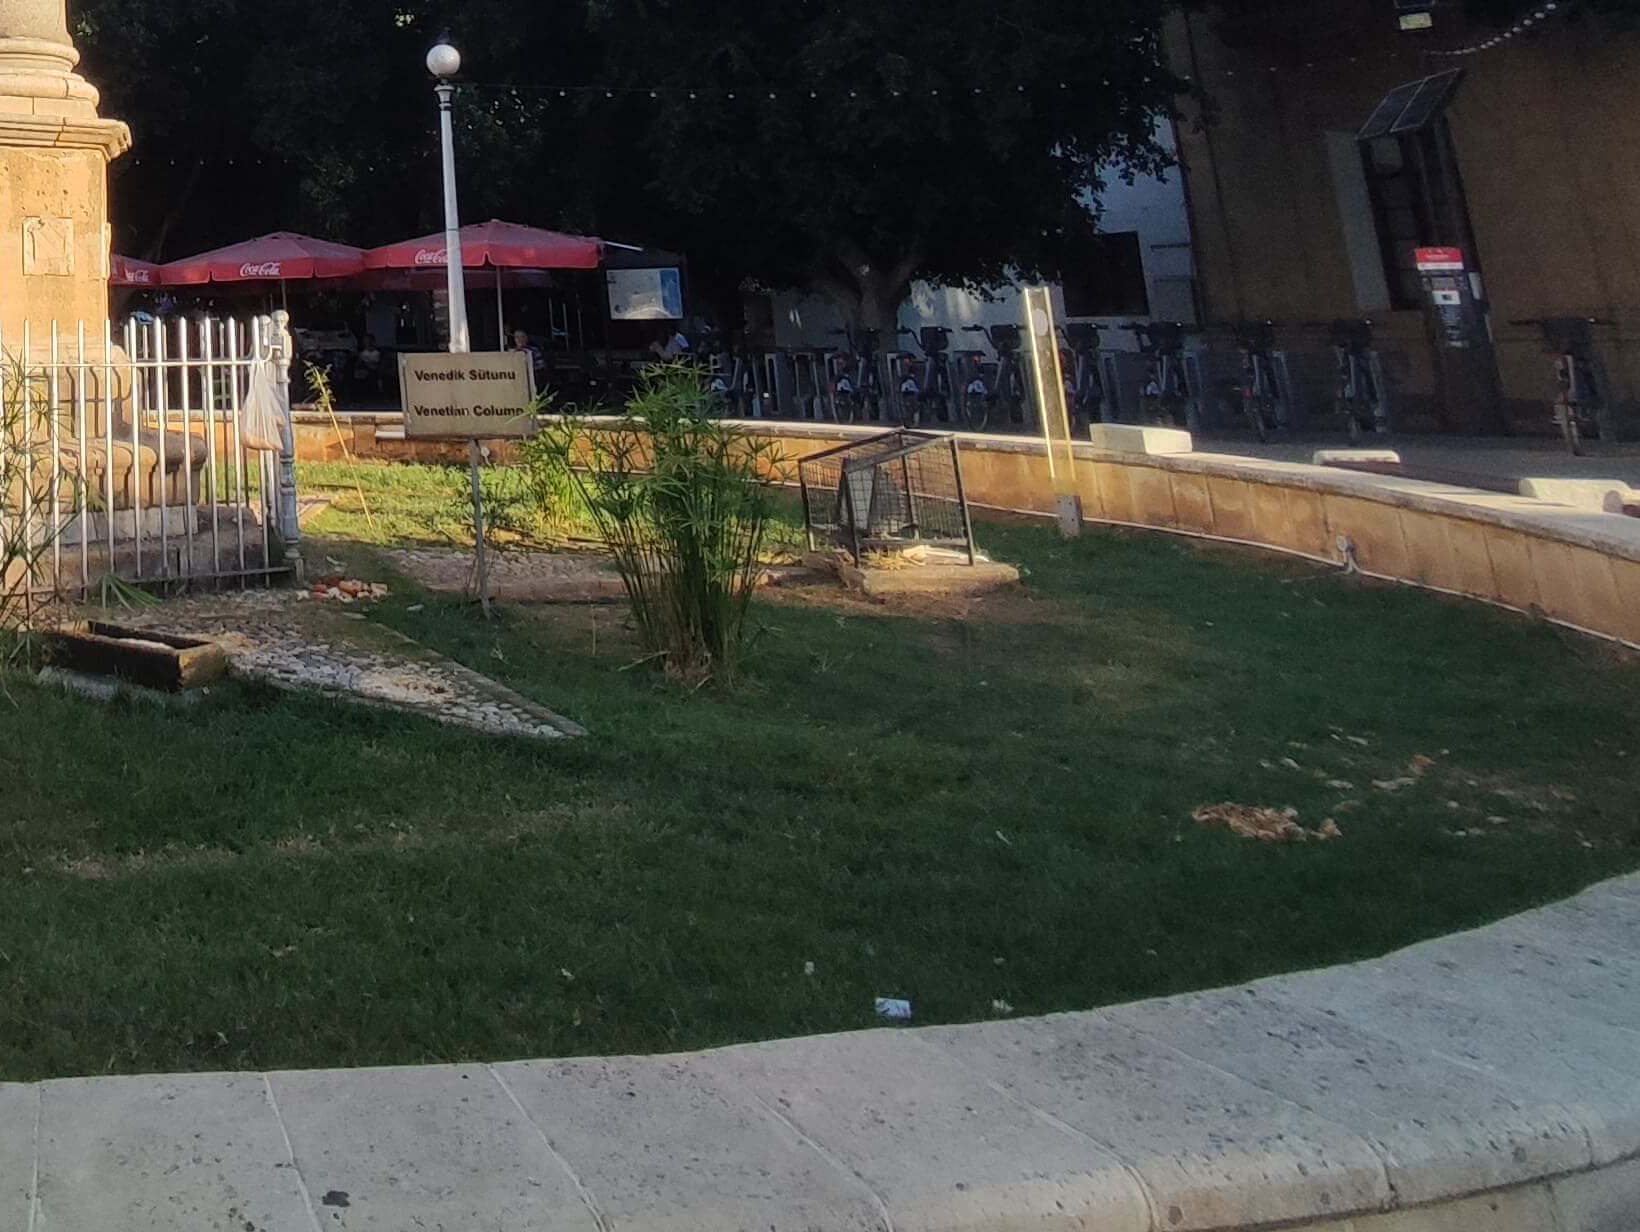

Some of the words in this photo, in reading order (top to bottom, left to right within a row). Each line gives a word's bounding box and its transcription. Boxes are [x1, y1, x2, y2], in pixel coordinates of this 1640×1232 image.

[413, 368, 466, 382] Venedik
[469, 368, 516, 381] Sütunu
[413, 404, 470, 417] Venetian
